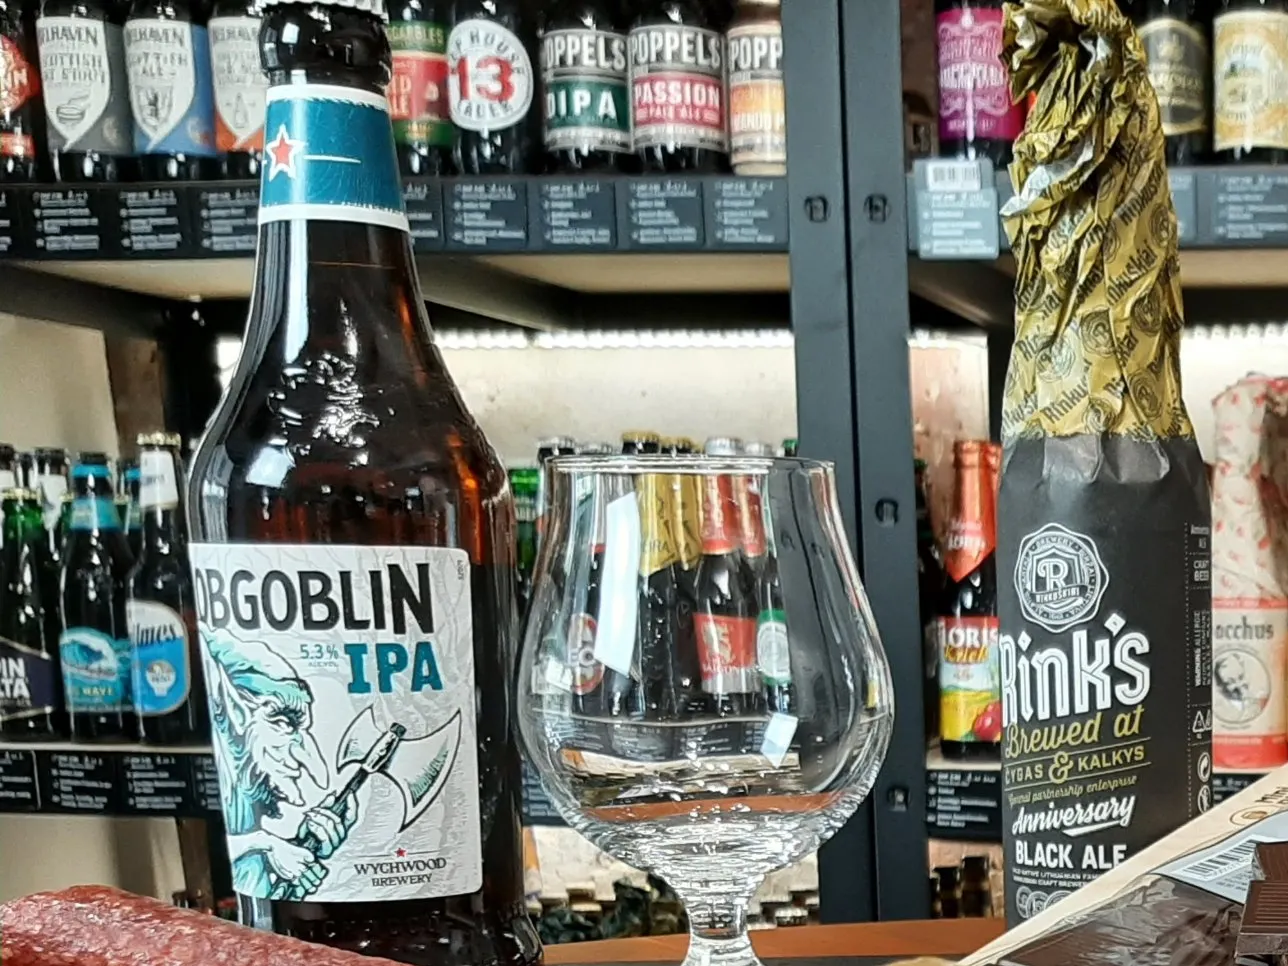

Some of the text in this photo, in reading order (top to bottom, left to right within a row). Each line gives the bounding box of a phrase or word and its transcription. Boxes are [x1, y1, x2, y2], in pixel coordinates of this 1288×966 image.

[545, 33, 626, 71] OPPELS
[631, 29, 721, 69] POPPELS
[457, 55, 515, 102] 13
[634, 80, 720, 109] PASSION
[1216, 615, 1274, 641] acchus
[343, 641, 444, 695] IPA
[1005, 704, 1145, 759] Brewed at
[1048, 751, 1074, 784] &
[1078, 745, 1146, 772] KALKYS
[1011, 796, 1136, 837] Anniversary
[354, 857, 447, 878] WYCHWOOD
[1015, 839, 1128, 870] BLACK ALE
[371, 873, 433, 887] BREWERY
